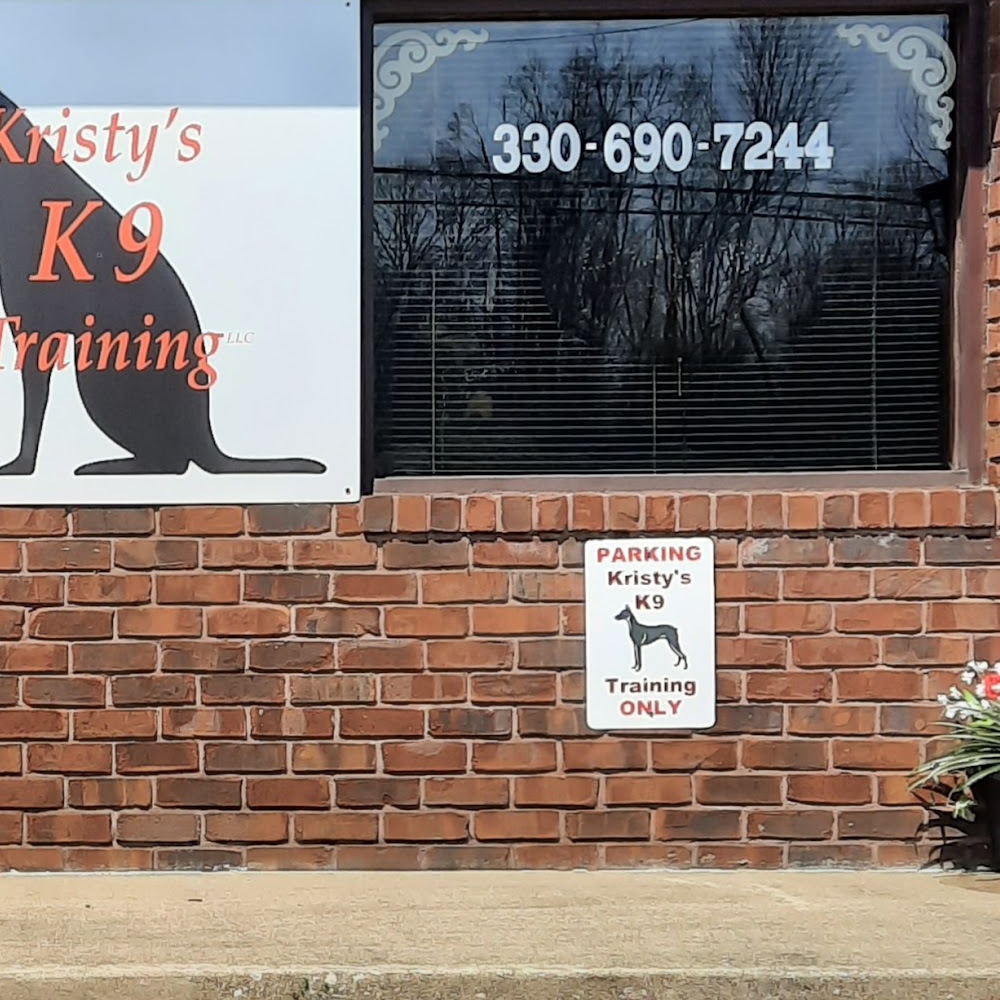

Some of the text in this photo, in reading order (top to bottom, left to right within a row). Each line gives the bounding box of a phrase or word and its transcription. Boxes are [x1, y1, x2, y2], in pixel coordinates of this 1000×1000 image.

[493, 122, 834, 174] 330-690-7244
[227, 331, 255, 343] LLC
[597, 546, 702, 562] PARKING
[608, 570, 692, 588] Kristy's
[635, 595, 665, 610] K9
[605, 678, 696, 695] Training
[620, 700, 682, 716] ONLY
